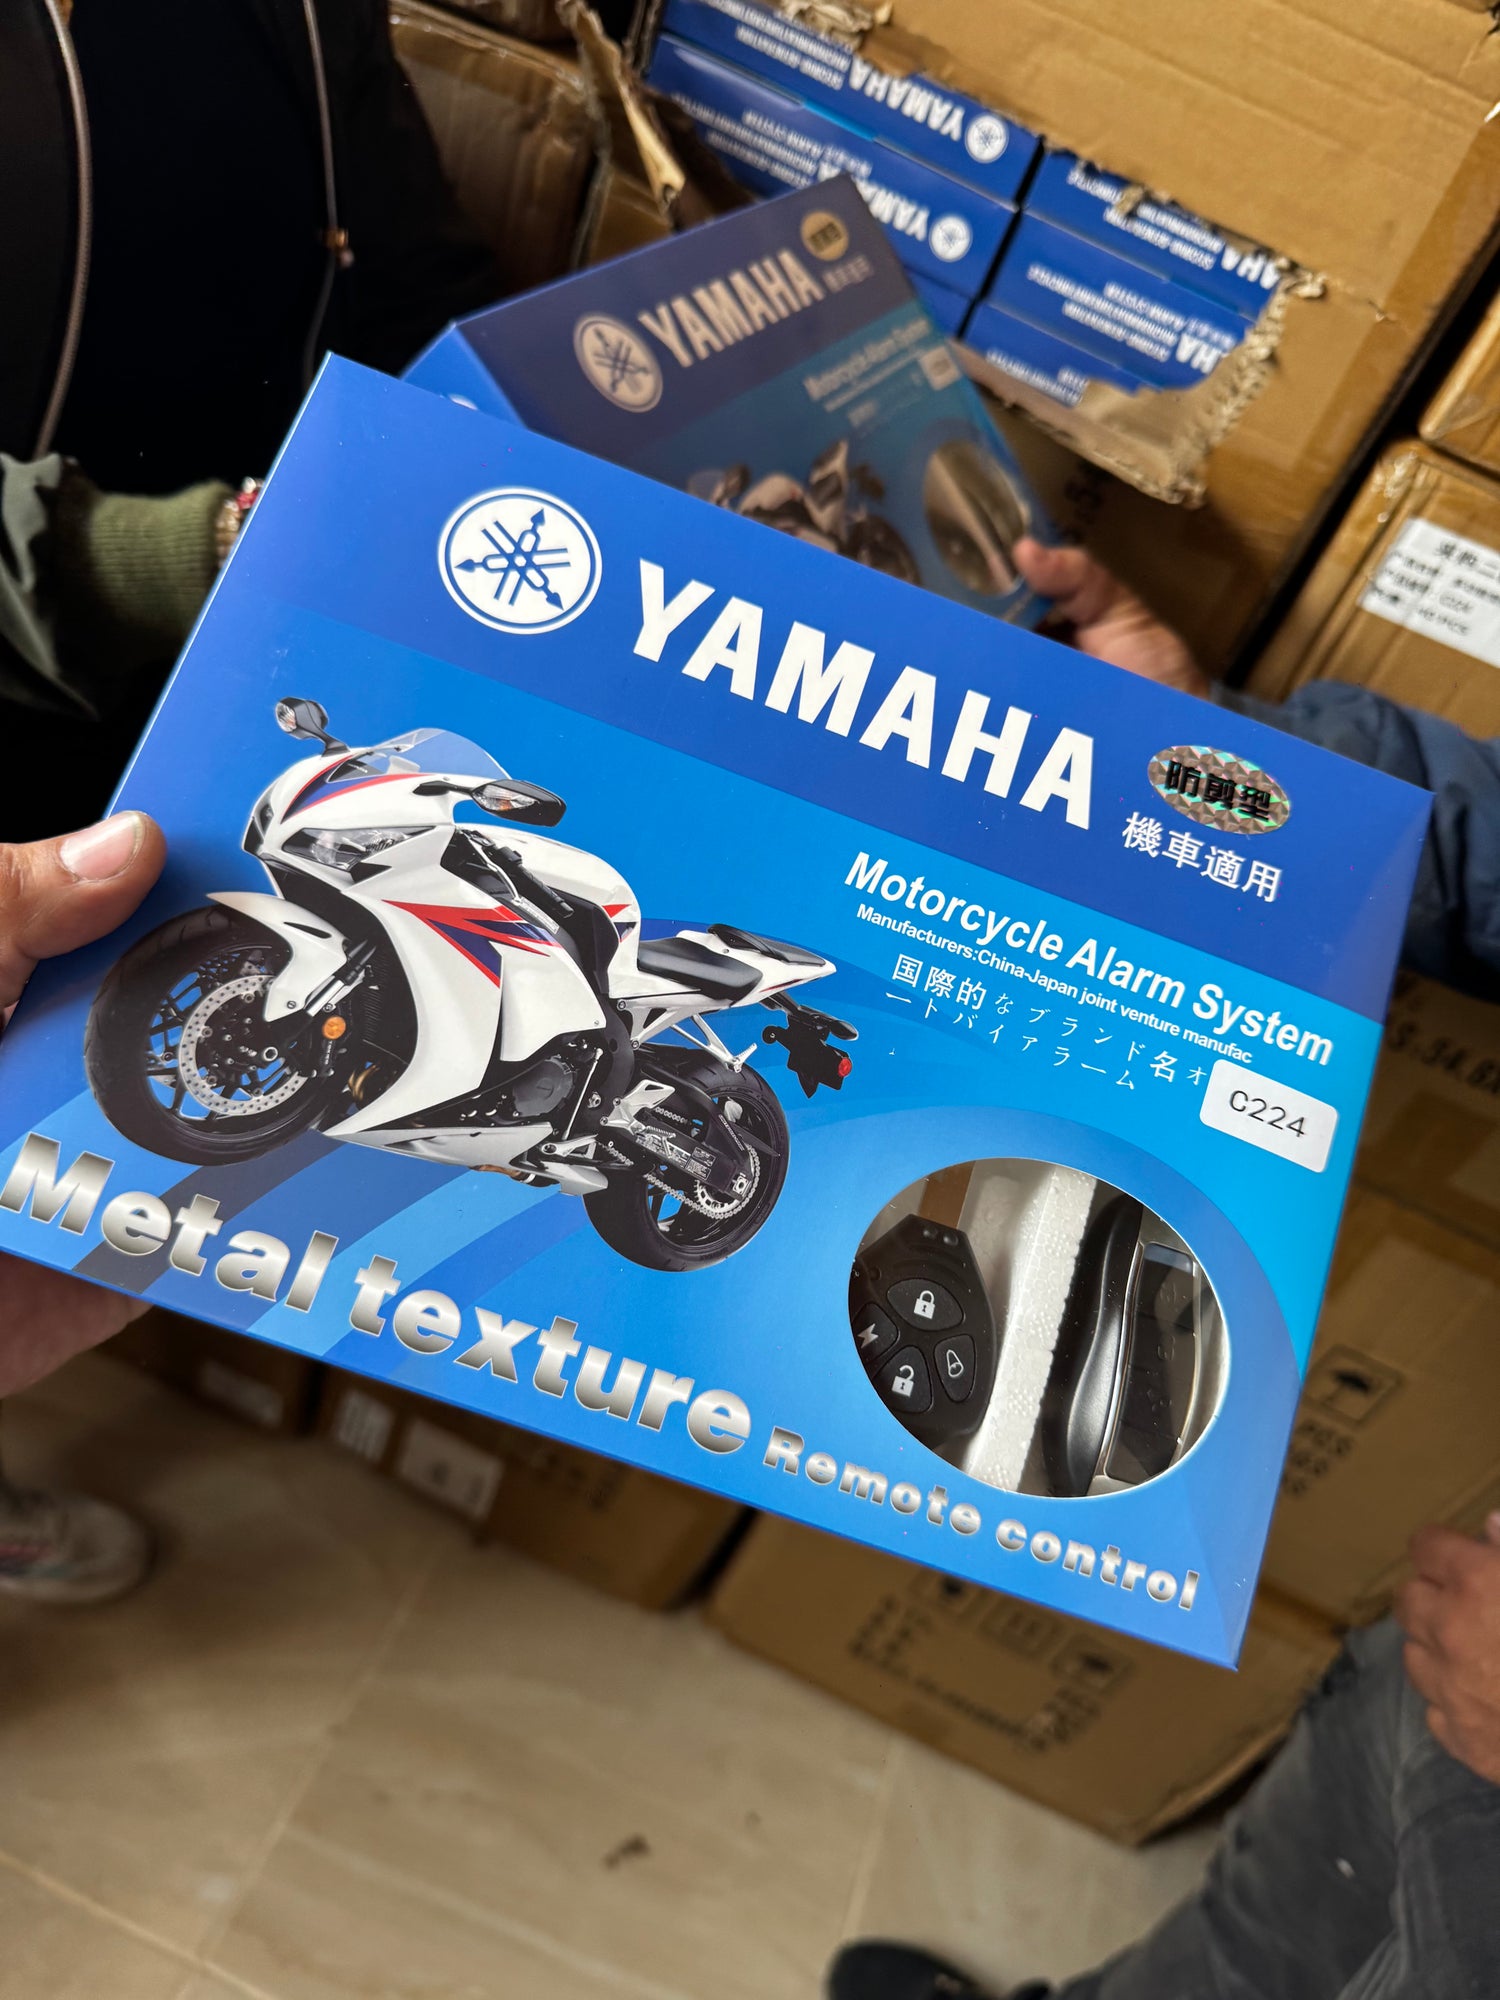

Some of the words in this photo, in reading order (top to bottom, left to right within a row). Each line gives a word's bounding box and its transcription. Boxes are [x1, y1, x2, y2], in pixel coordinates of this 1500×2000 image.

[638, 249, 824, 367] YAMAHA
[634, 559, 1097, 830] YAMAHA
[1122, 812, 1282, 902] 機車適用
[844, 851, 1063, 961] Motorcycle
[1066, 938, 1185, 1008] Alarm
[1192, 982, 1334, 1066] System
[856, 903, 1078, 999] Manufacturers:China-Japan
[1078, 984, 1118, 1016] joint
[1120, 1000, 1180, 1036] venture
[1182, 1027, 1253, 1063] manufac
[1229, 1089, 1306, 1139] C224
[0, 1131, 341, 1312] Metal
[348, 1255, 752, 1455] texture
[764, 1427, 983, 1535] Remote
[996, 1517, 1200, 1611] control
